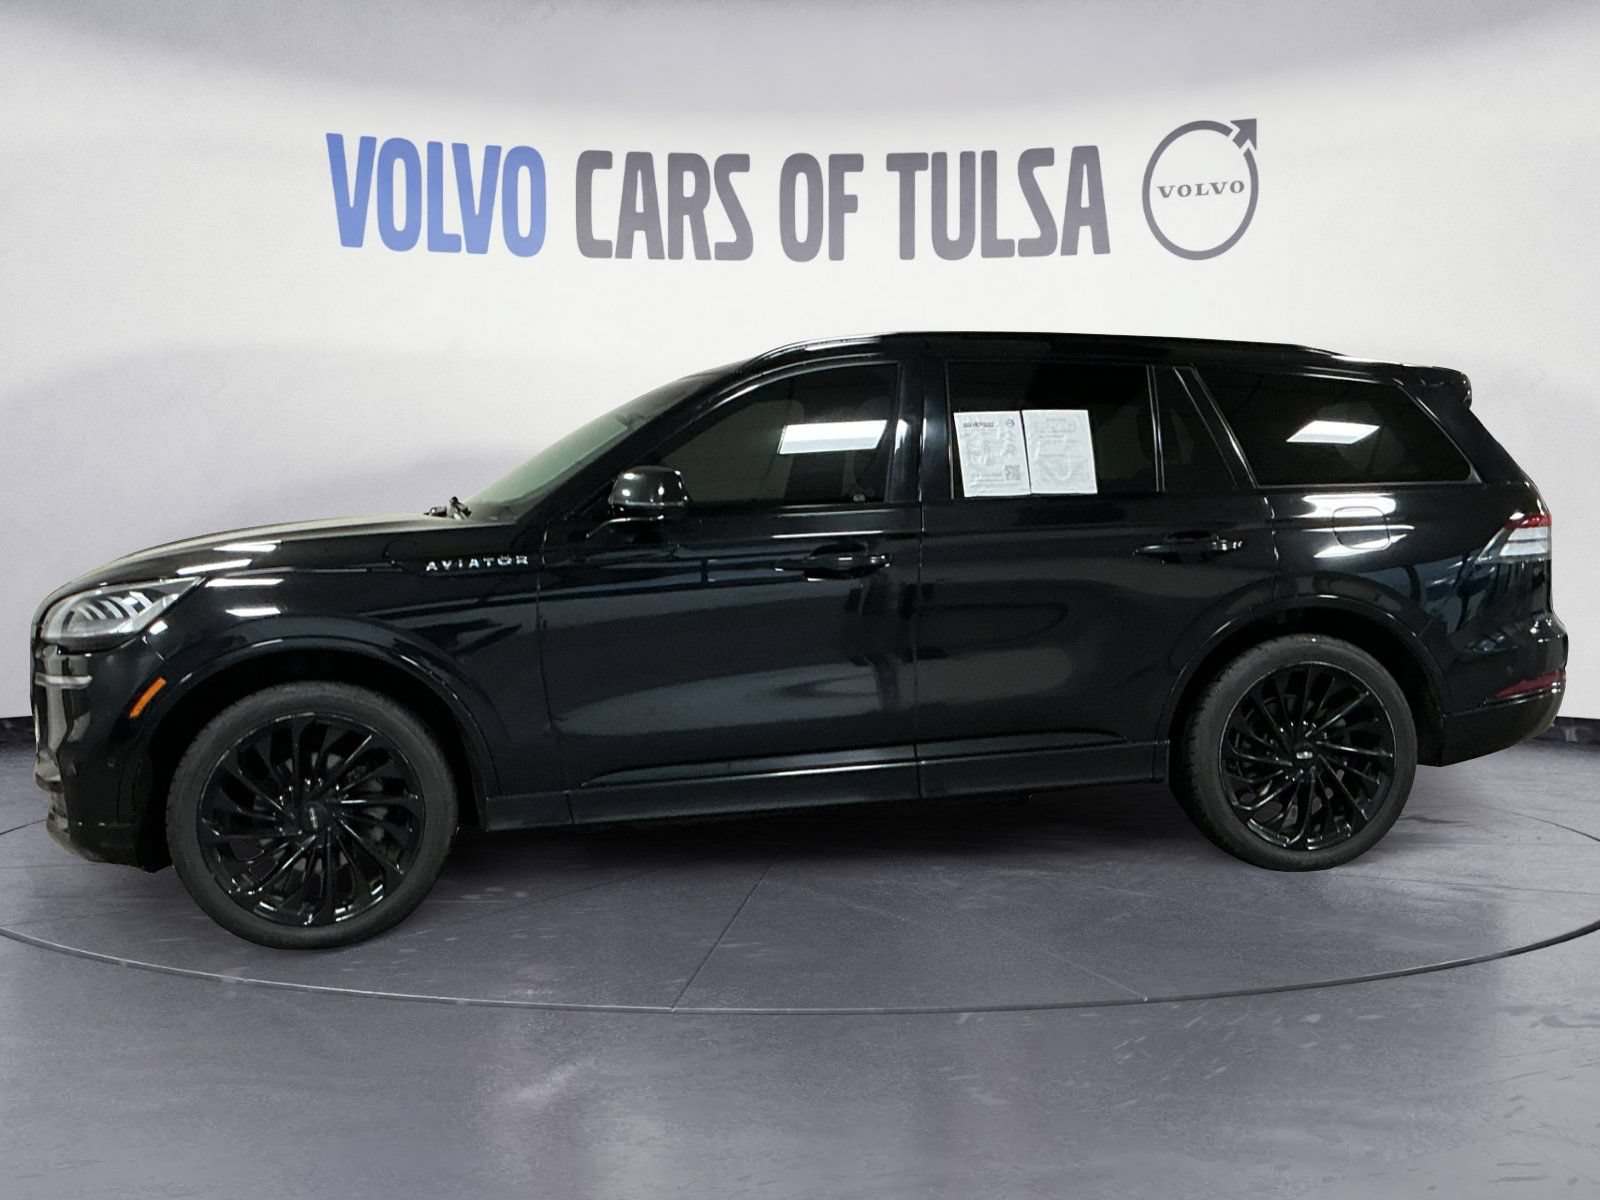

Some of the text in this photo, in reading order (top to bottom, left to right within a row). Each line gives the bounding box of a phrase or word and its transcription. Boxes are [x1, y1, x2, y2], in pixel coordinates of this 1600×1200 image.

[326, 133, 1110, 262] VOLVO CARS OF TULSA
[1157, 180, 1246, 198] VOLVO
[425, 554, 529, 572] AVIATOR
